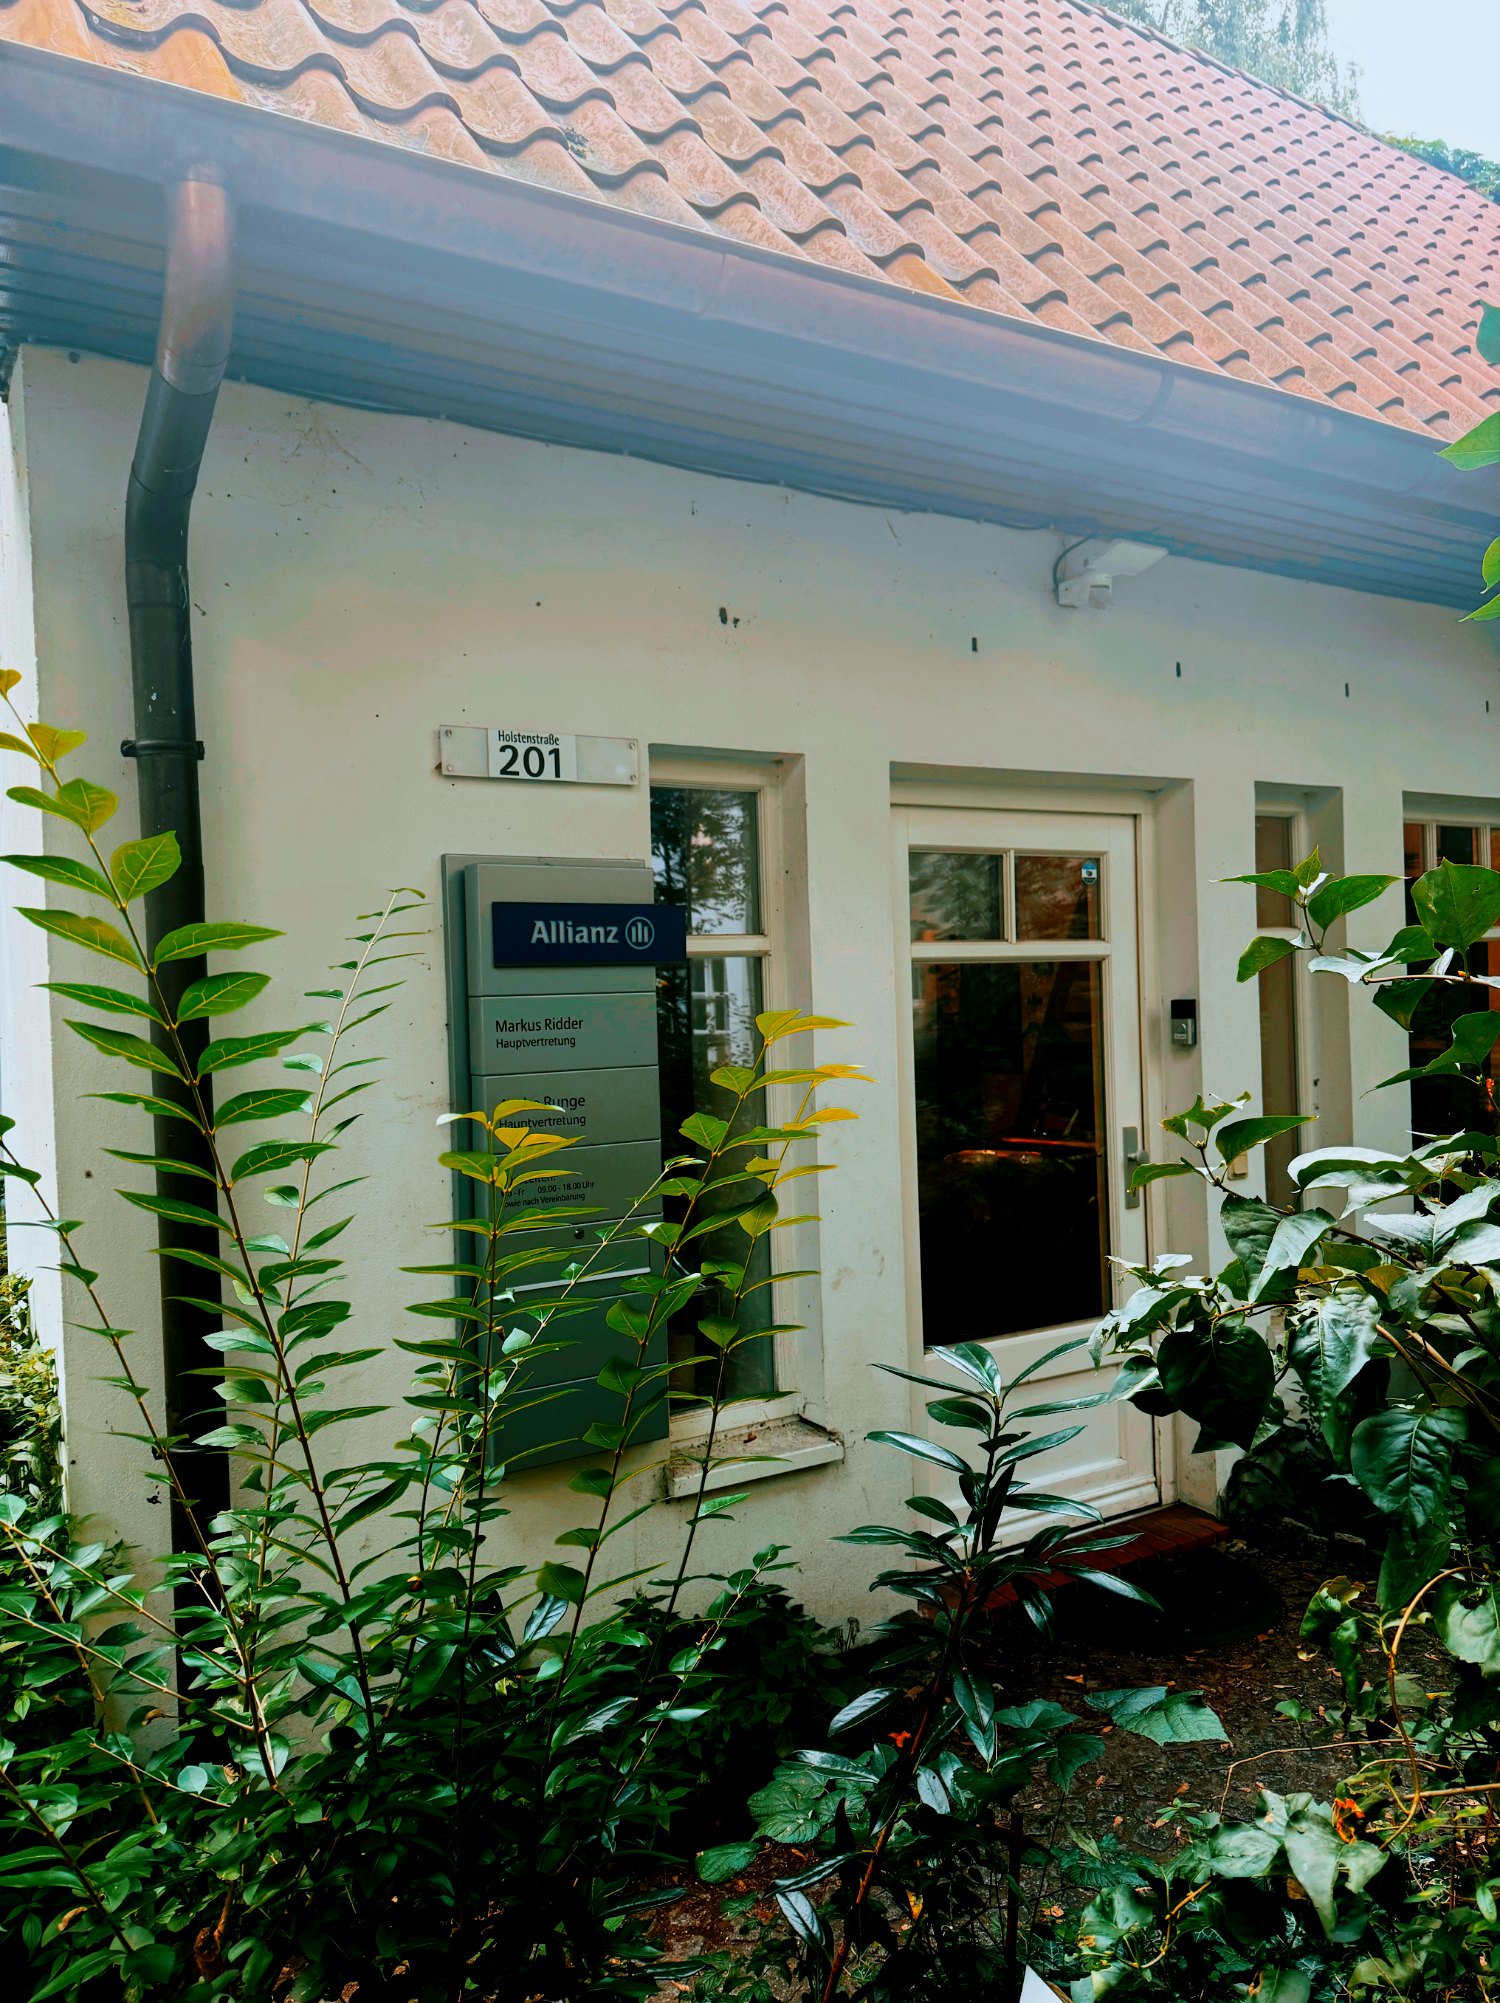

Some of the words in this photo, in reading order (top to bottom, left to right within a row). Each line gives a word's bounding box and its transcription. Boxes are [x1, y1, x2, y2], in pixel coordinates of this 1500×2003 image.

[497, 729, 560, 746] Holstenstraße
[498, 744, 561, 779] 201
[530, 920, 619, 944] Allianz
[495, 1019, 542, 1033] Markus
[545, 1016, 584, 1031] Ridder
[496, 1036, 576, 1051] Hauptvertretung
[544, 1095, 586, 1111] Runge
[499, 1115, 586, 1130] Hauptvertretung
[518, 1188, 525, 1196] Fr
[537, 1183, 557, 1194] 09.00
[562, 1181, 581, 1192] 18.00
[582, 1180, 595, 1190] Uhr
[502, 1200, 521, 1208] owie
[522, 1197, 539, 1207] nach
[539, 1192, 586, 1205] Vereinbarung
